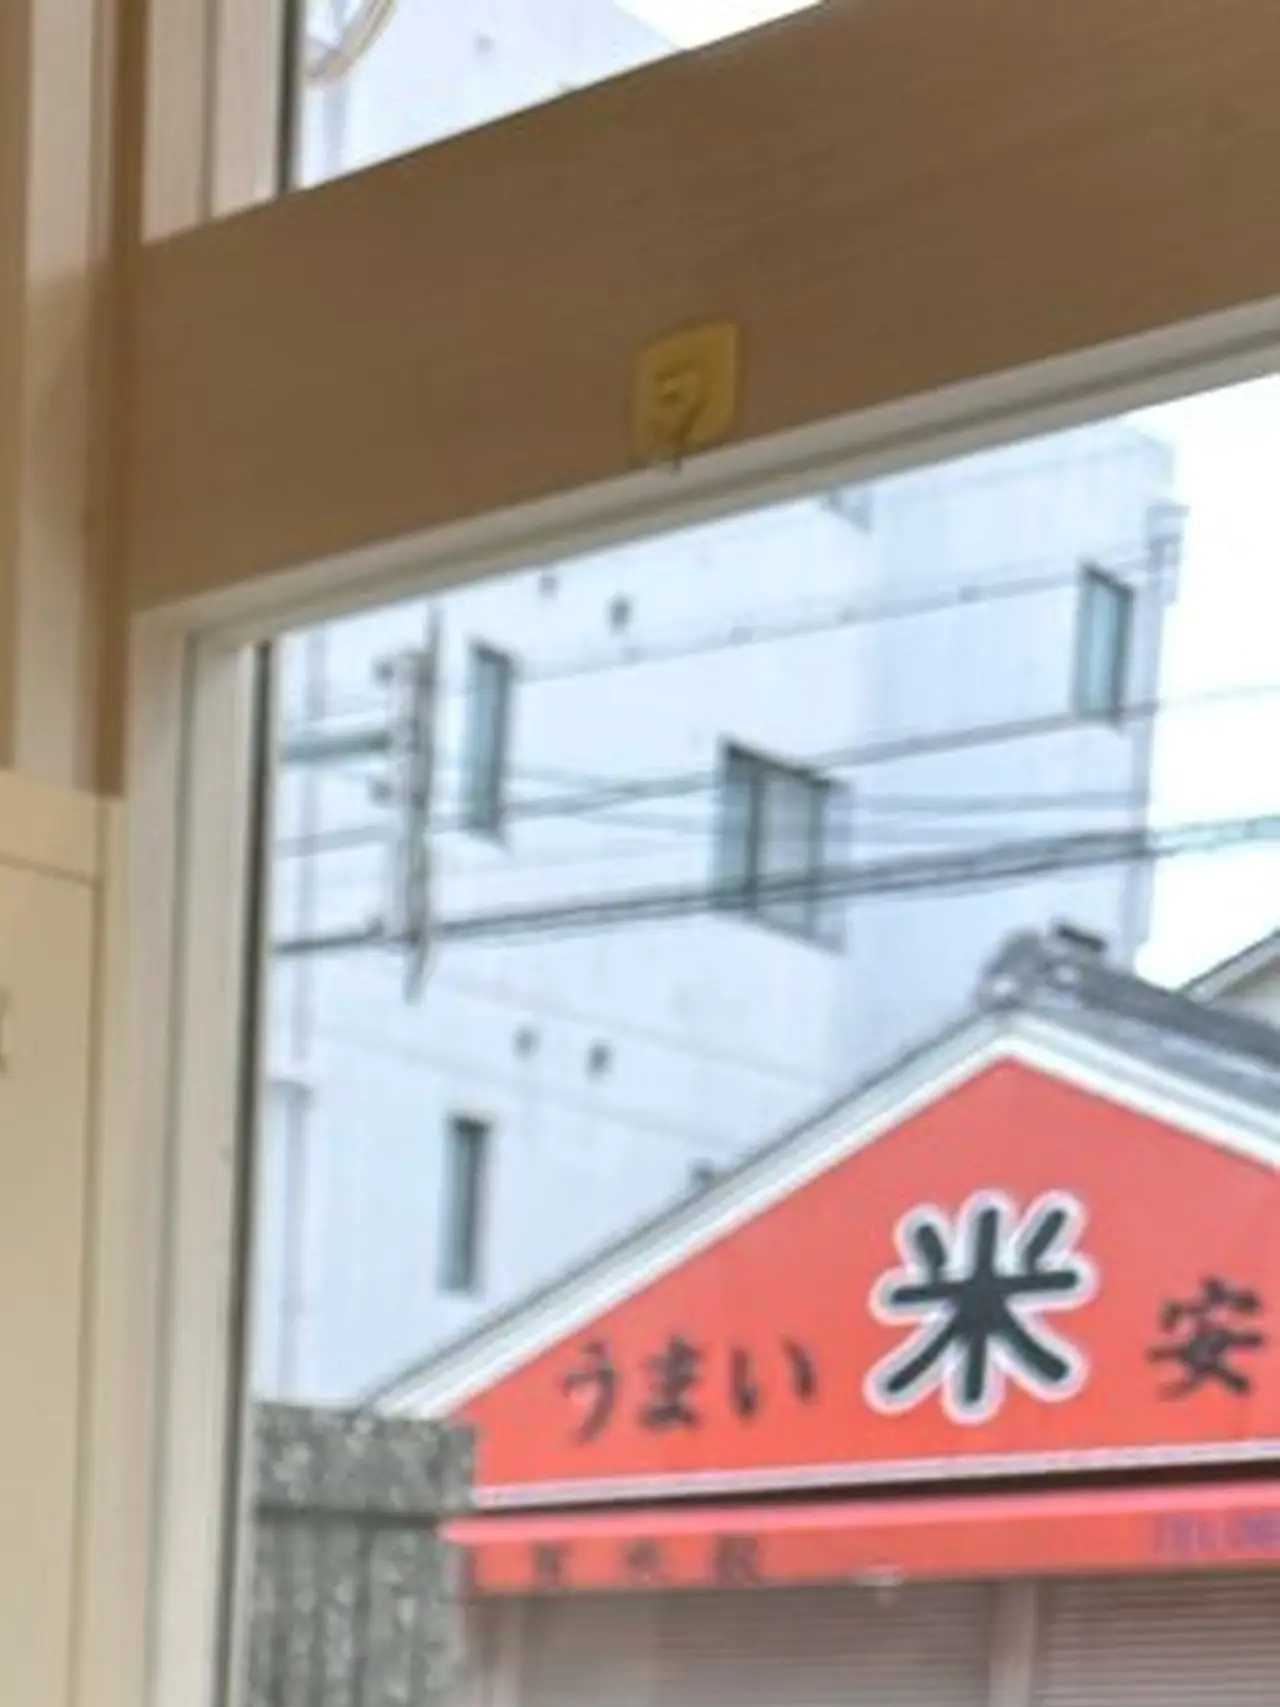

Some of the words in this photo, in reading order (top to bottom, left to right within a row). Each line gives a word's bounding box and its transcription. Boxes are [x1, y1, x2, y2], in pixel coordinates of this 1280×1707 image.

[563, 1334, 819, 1440] うまい
[886, 1206, 1080, 1406] 米
[1150, 1276, 1265, 1396] 安
